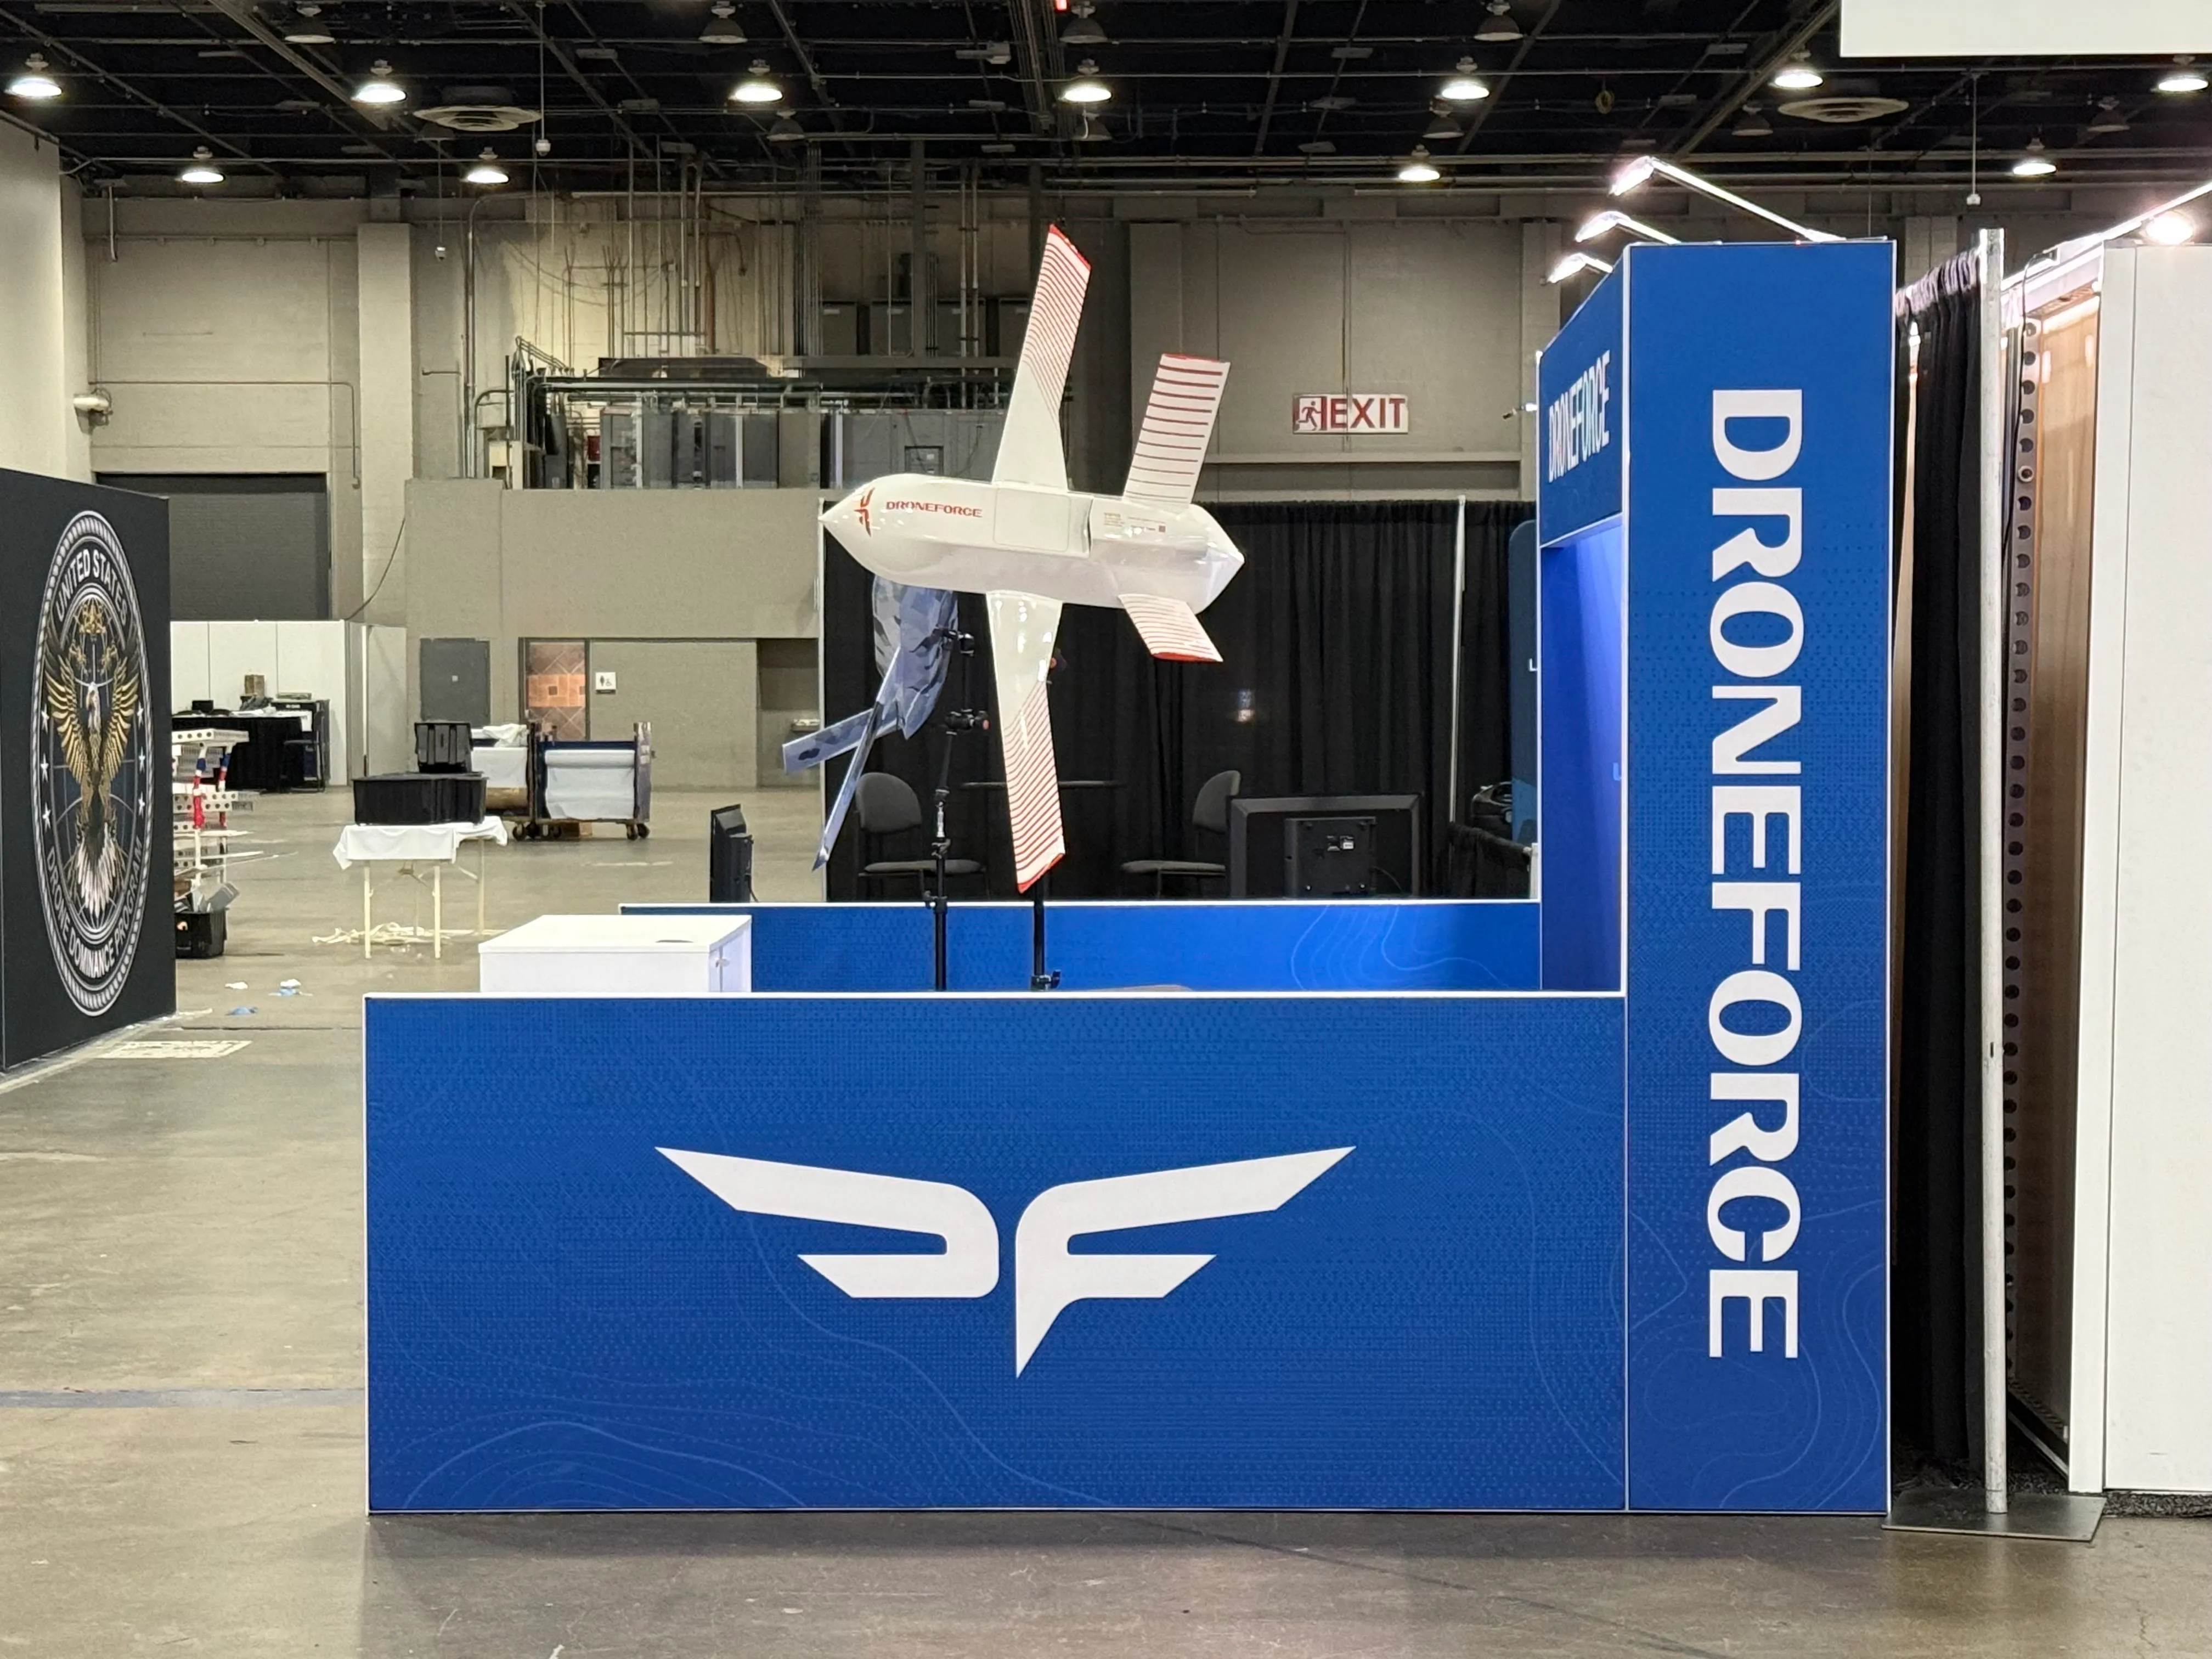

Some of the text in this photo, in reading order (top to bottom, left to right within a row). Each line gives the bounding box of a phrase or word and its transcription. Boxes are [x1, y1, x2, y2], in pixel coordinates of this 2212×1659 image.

[1330, 398, 1406, 429] EXIT
[1549, 349, 1611, 483] DRONEFORCE
[885, 501, 983, 518] DRONEFORCE
[55, 549, 127, 626] UNITED STATES
[47, 834, 143, 979] DRONE DOMINANCE PROGRAM
[1707, 388, 1805, 1359] DRONEFORCE
